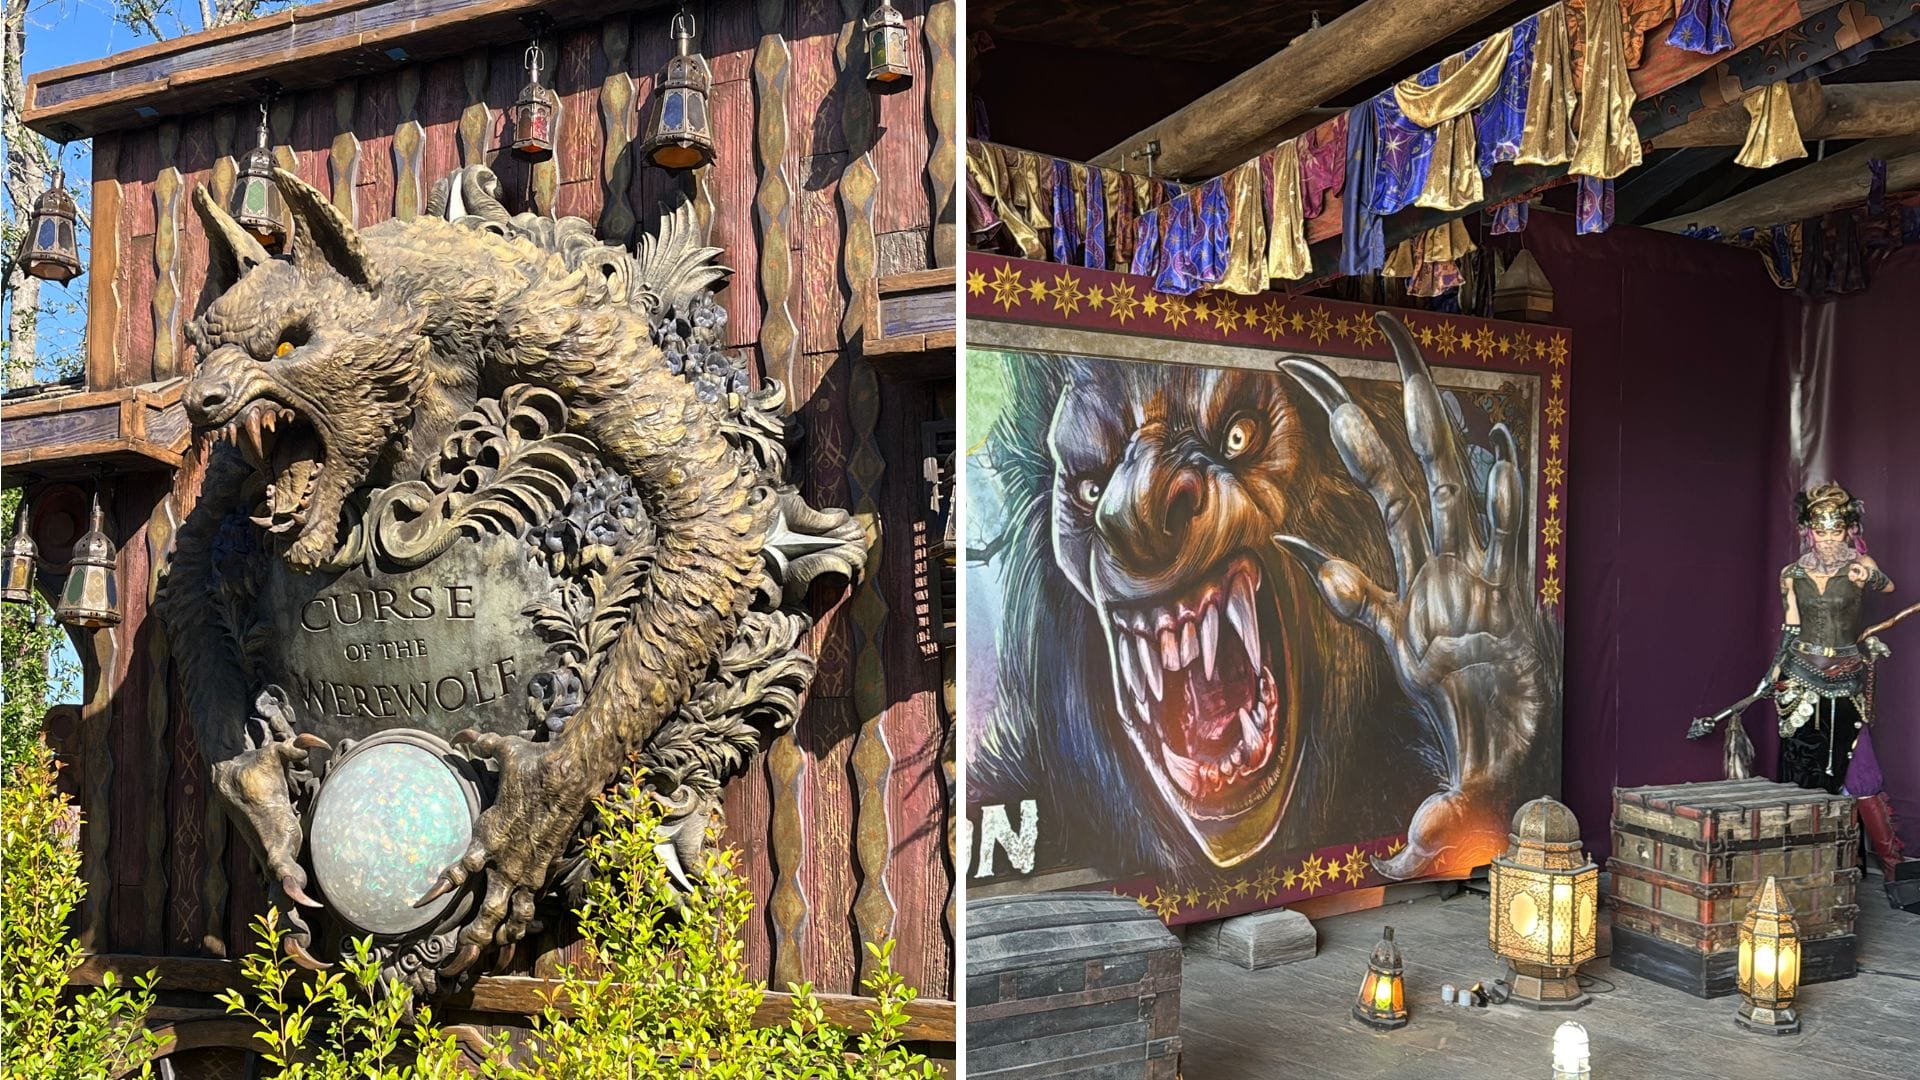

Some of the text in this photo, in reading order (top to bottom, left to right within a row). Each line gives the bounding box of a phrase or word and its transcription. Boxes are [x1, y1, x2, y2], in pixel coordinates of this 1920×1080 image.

[301, 585, 476, 632] CURSE
[343, 639, 428, 662] OF THE
[301, 656, 517, 718] WEREWOLF
